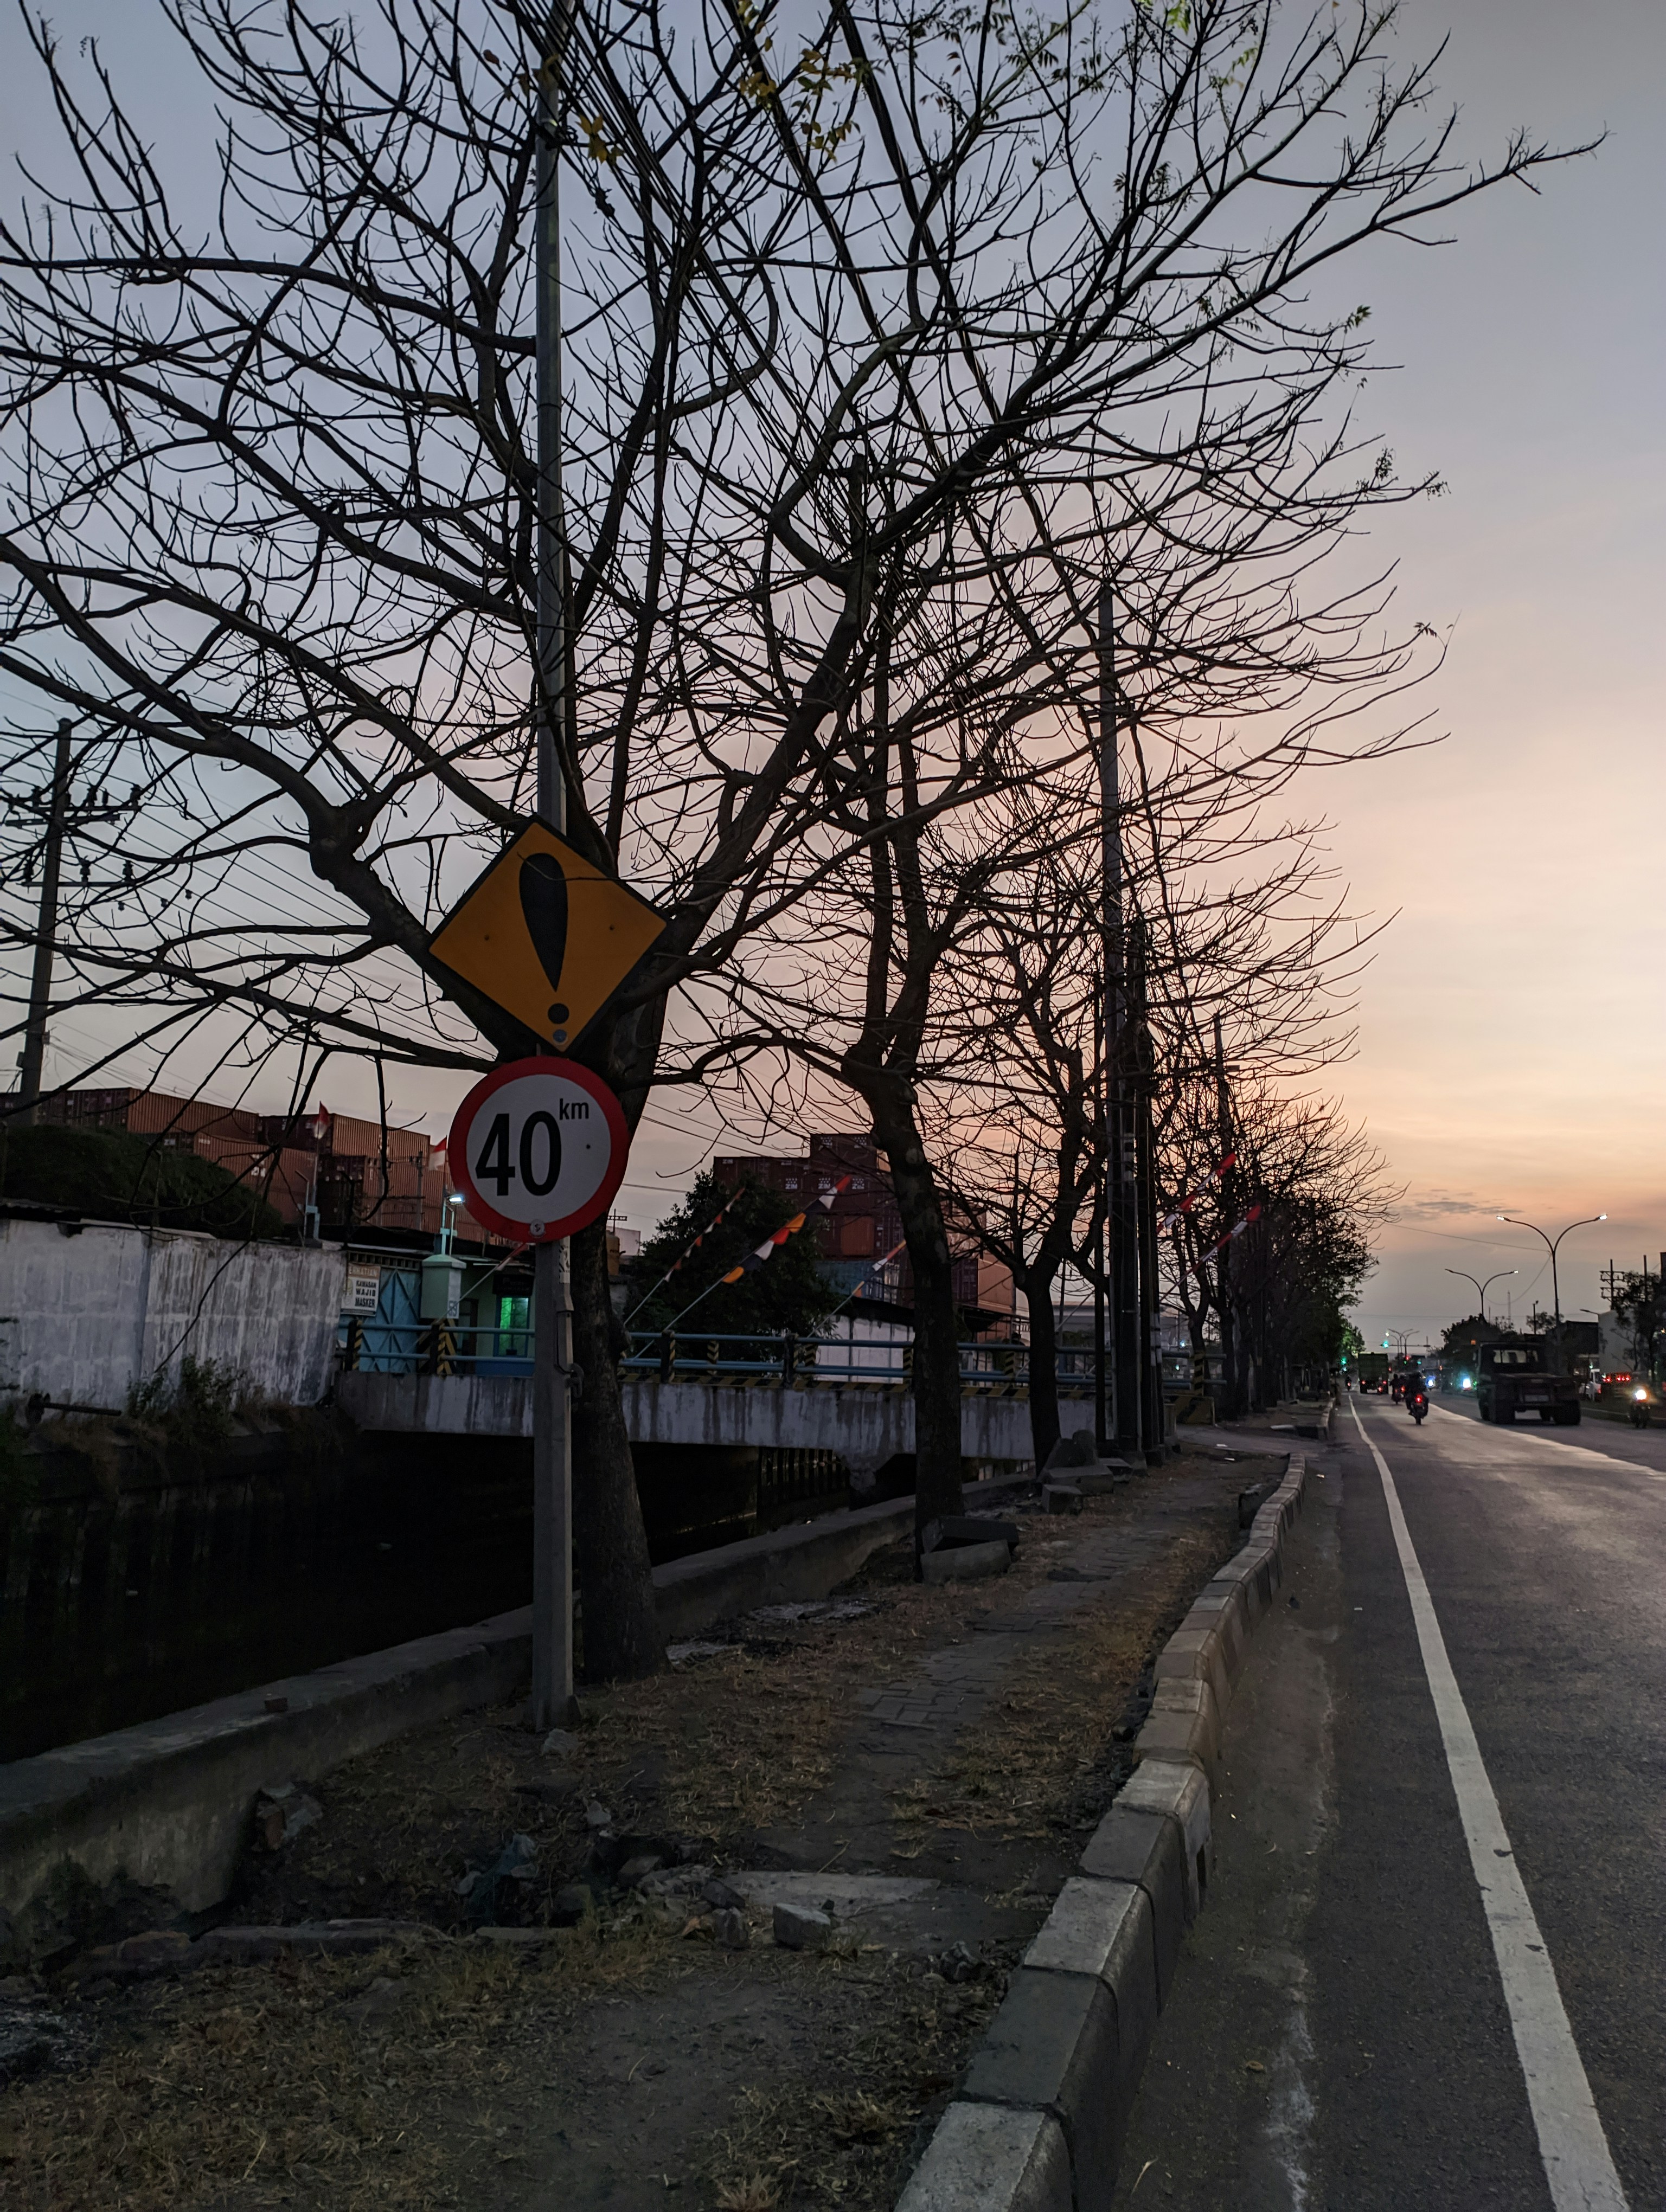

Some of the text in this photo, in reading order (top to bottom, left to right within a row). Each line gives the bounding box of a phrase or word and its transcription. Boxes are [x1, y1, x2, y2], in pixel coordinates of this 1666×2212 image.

[475, 1098, 589, 1196] 40 km
[356, 1280, 376, 1288] KAWASAN
[356, 1288, 376, 1296] WAJIB
[355, 1297, 375, 1308] MASKER
